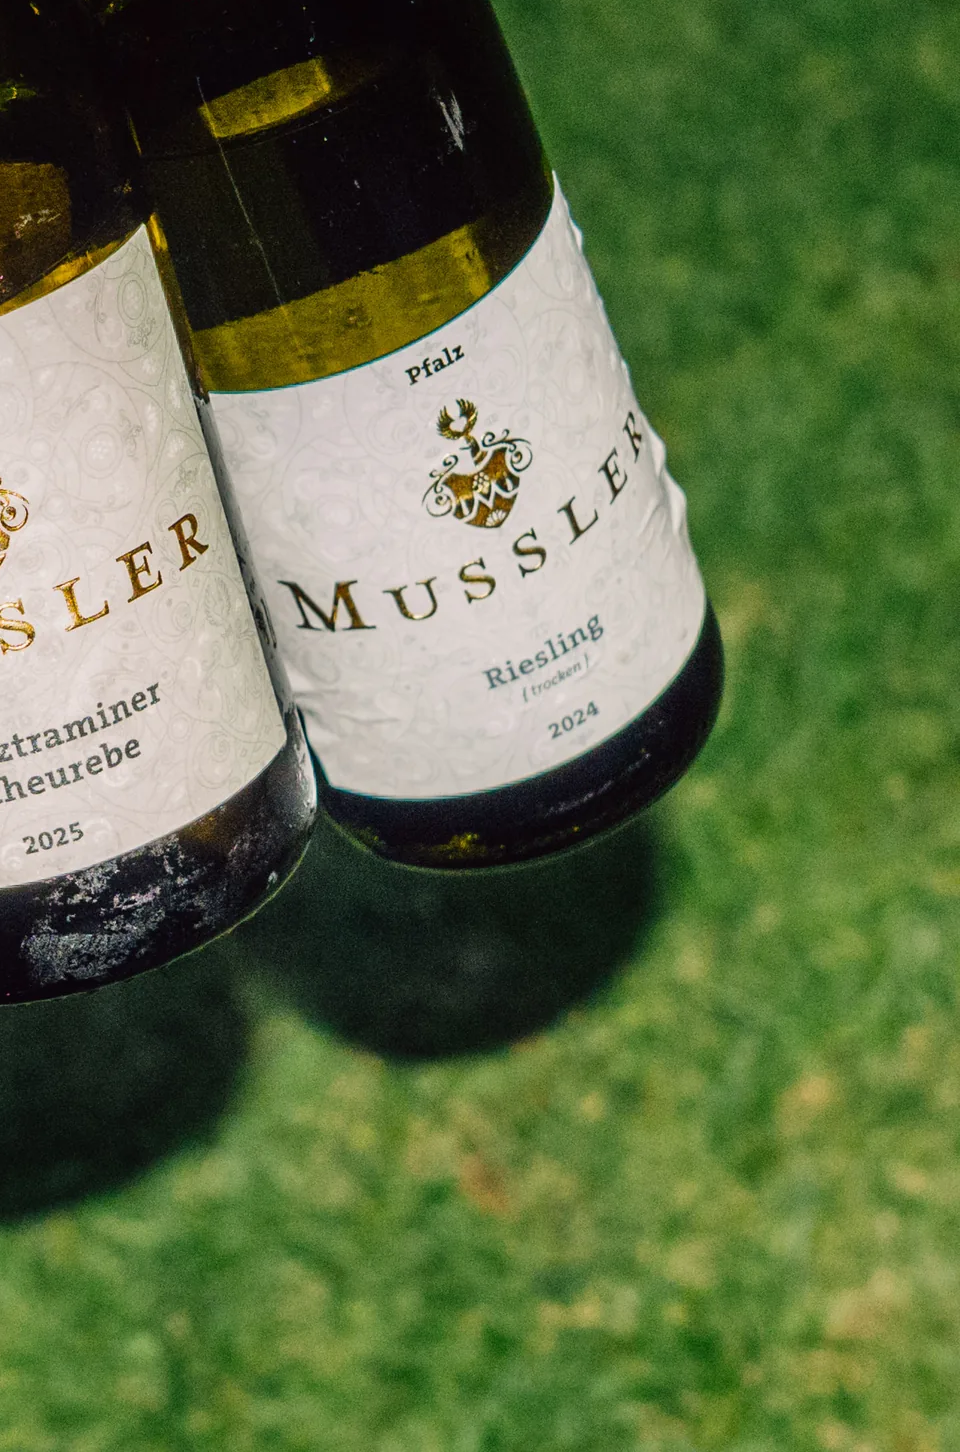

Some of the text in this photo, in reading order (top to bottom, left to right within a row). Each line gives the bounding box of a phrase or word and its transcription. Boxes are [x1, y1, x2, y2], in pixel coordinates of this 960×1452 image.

[404, 344, 465, 386] Pfalz
[277, 411, 643, 632] MUSSLER
[481, 613, 604, 691] Riesling
[548, 700, 600, 740] 2024
[22, 821, 85, 855] 2025
